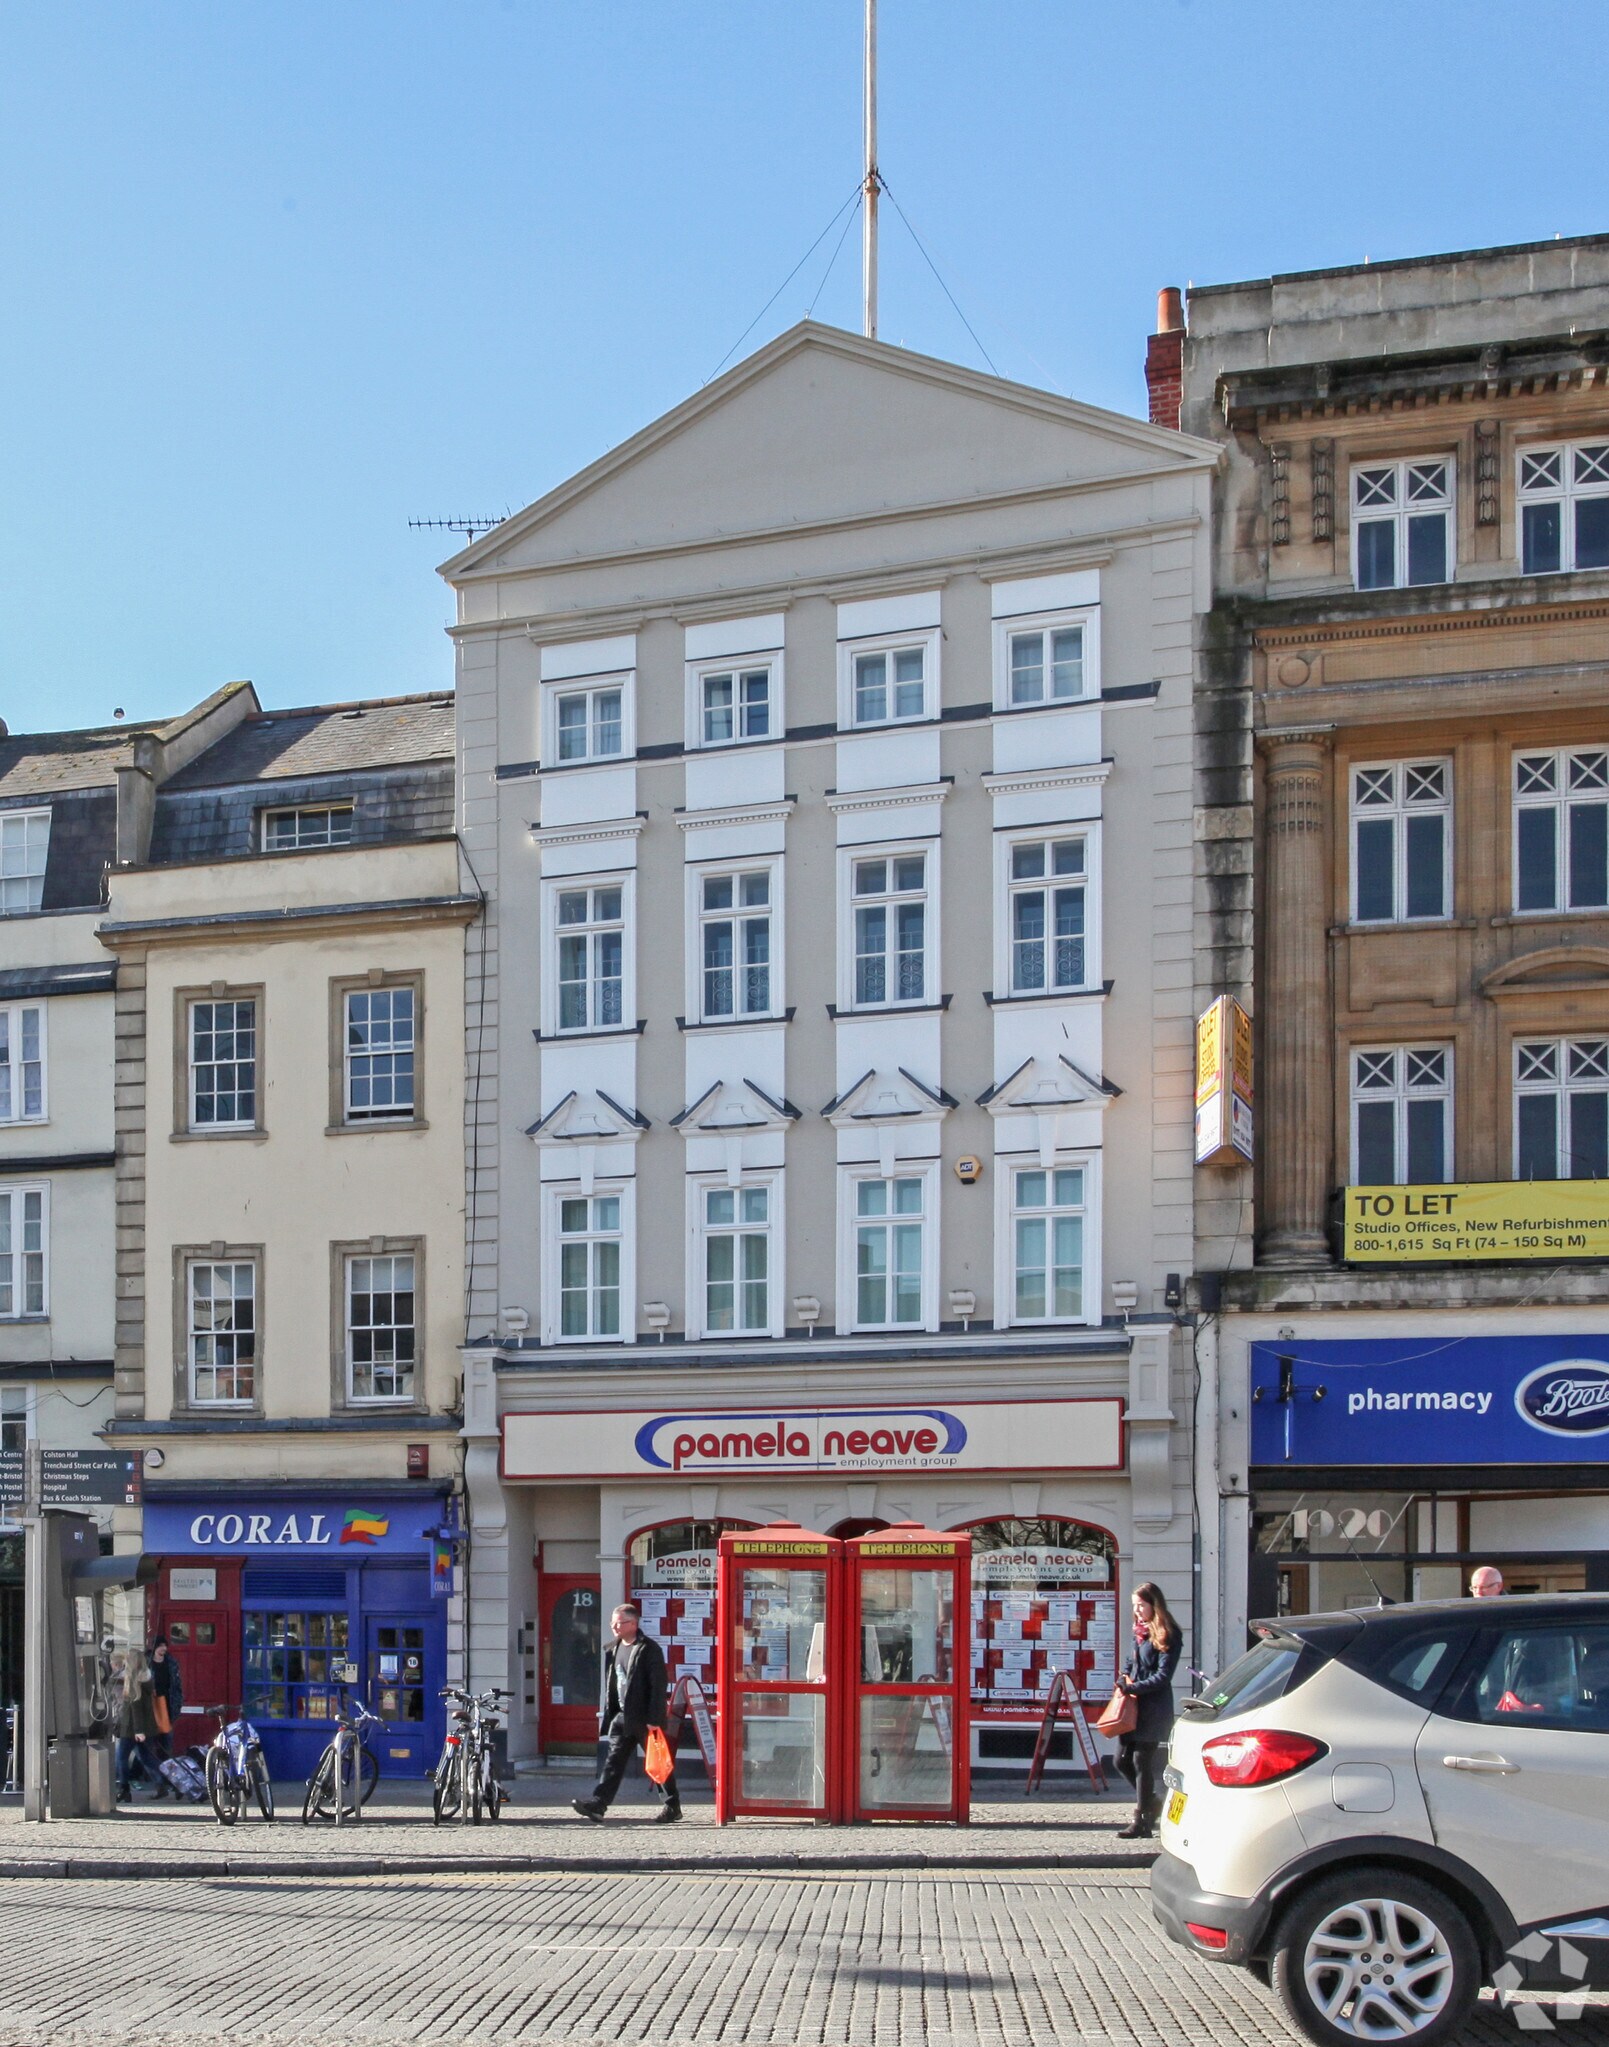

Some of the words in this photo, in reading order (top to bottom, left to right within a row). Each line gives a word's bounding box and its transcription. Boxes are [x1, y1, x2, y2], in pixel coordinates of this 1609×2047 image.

[1354, 1195, 1394, 1217] TO
[1404, 1193, 1458, 1216] LET
[1354, 1222, 1400, 1234] Studio
[1405, 1220, 1461, 1234] Offices,
[1465, 1220, 1498, 1232] New
[1503, 1216, 1609, 1231] Refurbishmen
[1354, 1238, 1424, 1253] 800-1,615
[1432, 1238, 1451, 1251] Sq
[1456, 1237, 1471, 1249] Ft
[1475, 1235, 1496, 1251] (74
[1513, 1235, 1539, 1248] 150
[1543, 1235, 1563, 1249] Sq
[1567, 1234, 1586, 1249] M)
[1348, 1387, 1493, 1415] pharmacy
[672, 1421, 810, 1471] pamela
[823, 1428, 938, 1456] neave
[839, 1456, 917, 1468] employment
[921, 1456, 958, 1467] group
[73, 1473, 90, 1481] Steps
[189, 1513, 331, 1545] CORAL
[1290, 1508, 1394, 1539] 1920
[739, 1542, 822, 1554] TELEPHONE
[867, 1543, 950, 1554] TELEPHONE
[656, 1554, 711, 1572] pamela
[977, 1551, 1038, 1569] pamela
[1044, 1553, 1094, 1566] neave
[982, 1566, 1052, 1574] employment
[1058, 1566, 1094, 1574] group
[434, 1581, 451, 1591] CORAL
[572, 1592, 594, 1607] 18
